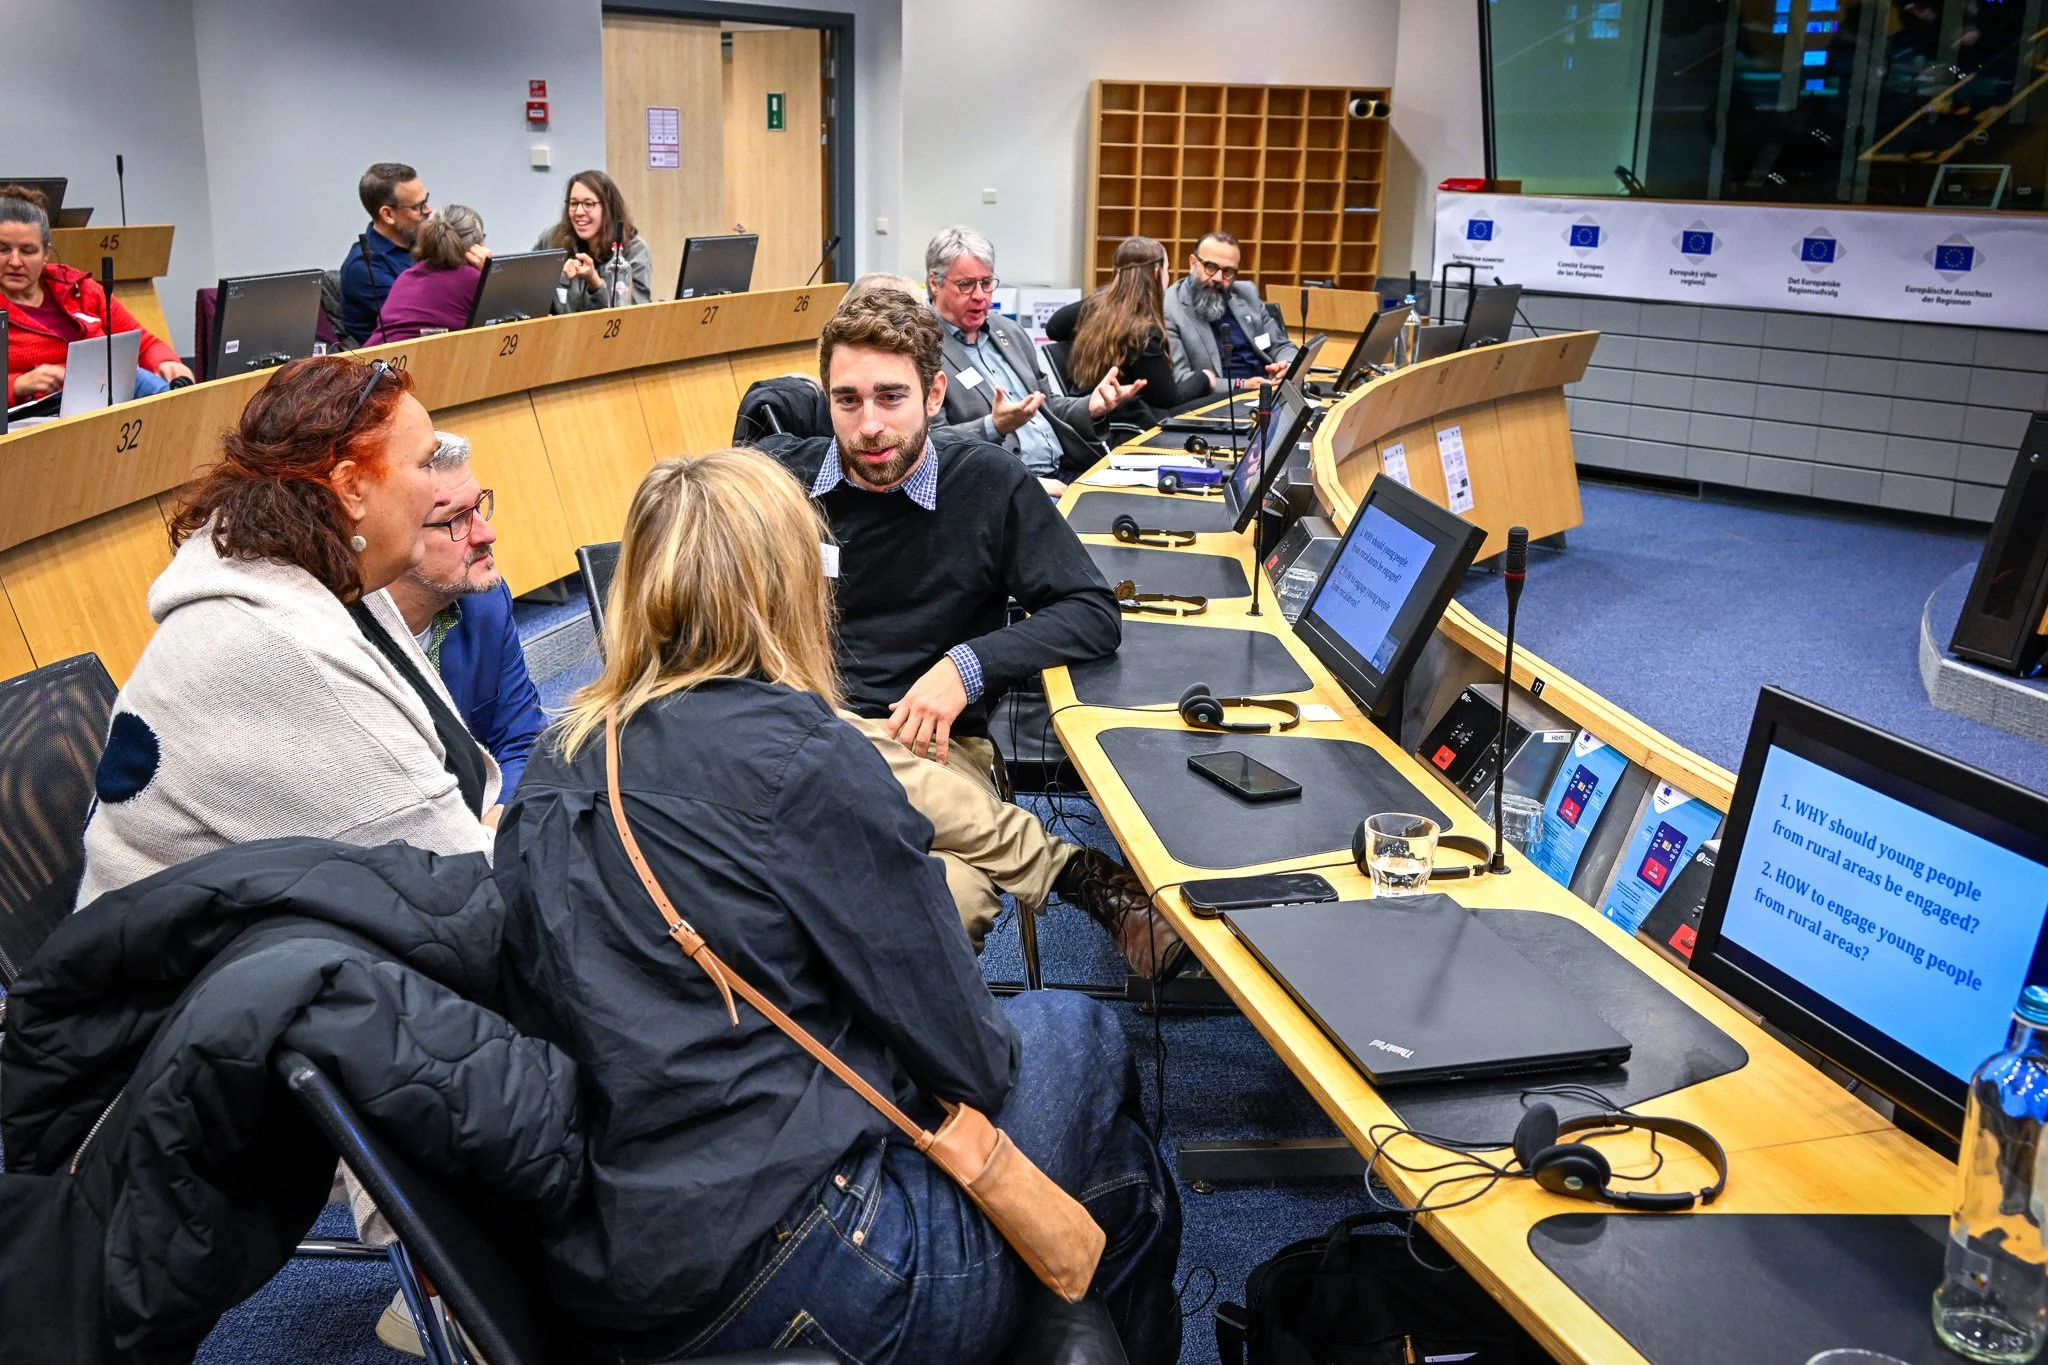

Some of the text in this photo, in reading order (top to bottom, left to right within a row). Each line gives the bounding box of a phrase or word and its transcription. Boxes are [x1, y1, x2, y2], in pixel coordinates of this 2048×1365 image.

[100, 234, 120, 251] 45
[1575, 270, 1603, 279] Regiones
[1788, 286, 1839, 298] Regionsudvalg
[1905, 285, 1993, 298] Europäischer Ausschuss
[1936, 296, 1971, 306] Regionen
[794, 295, 810, 312] 26
[701, 306, 719, 325] 27
[603, 318, 621, 339] 28
[499, 333, 519, 357] 29
[116, 418, 142, 453] 32
[1534, 681, 1543, 693] 17
[1781, 794, 1982, 902] 1. WHY should young people
[1772, 819, 1981, 934] from rural areas be engaged?
[1754, 887, 1870, 962] from rural areas?
[1761, 861, 1983, 992] 2. HOW to engage young people
[1368, 1039, 1415, 1059] ThinkPad
